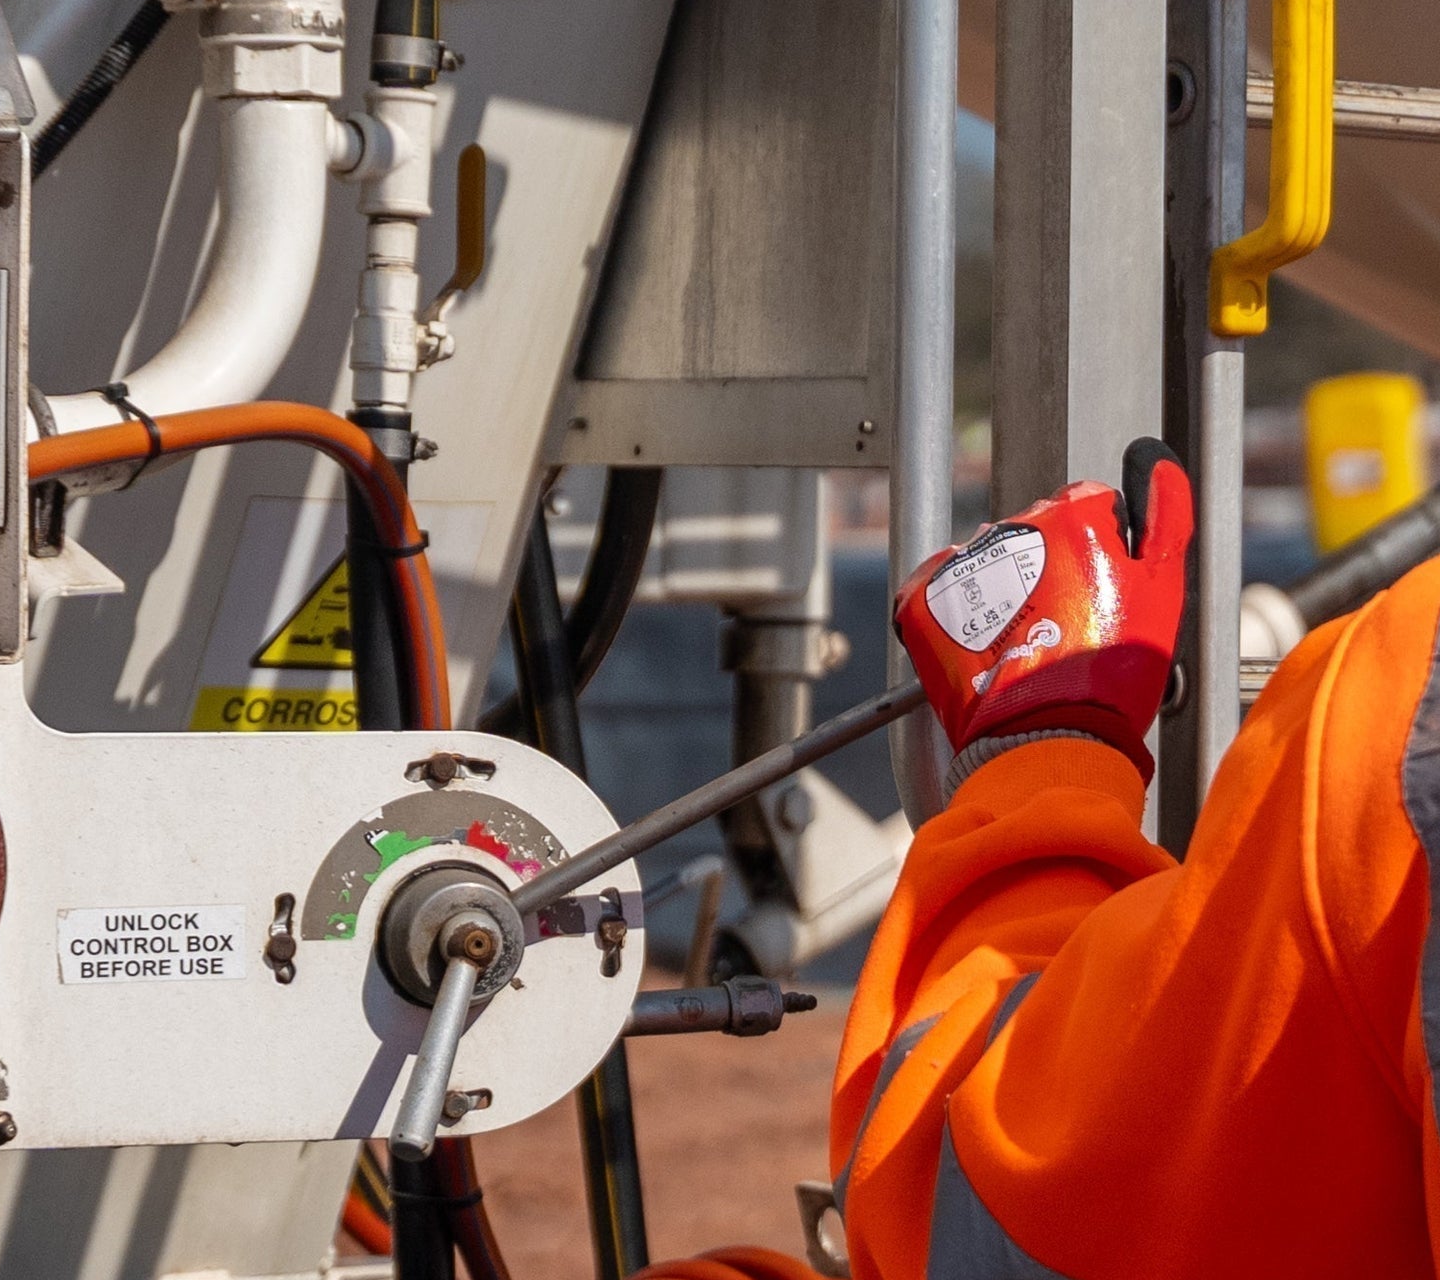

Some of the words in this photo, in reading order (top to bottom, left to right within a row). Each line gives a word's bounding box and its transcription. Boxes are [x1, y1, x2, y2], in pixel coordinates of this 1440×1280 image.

[952, 561, 976, 578] Grip
[990, 544, 1008, 558] Oil
[1023, 571, 1037, 581] 11
[104, 912, 200, 932] UNLOCK
[70, 936, 179, 956] CONTROL
[186, 934, 234, 952] BOX
[80, 959, 172, 978] BEFORE
[179, 957, 224, 975] USE
